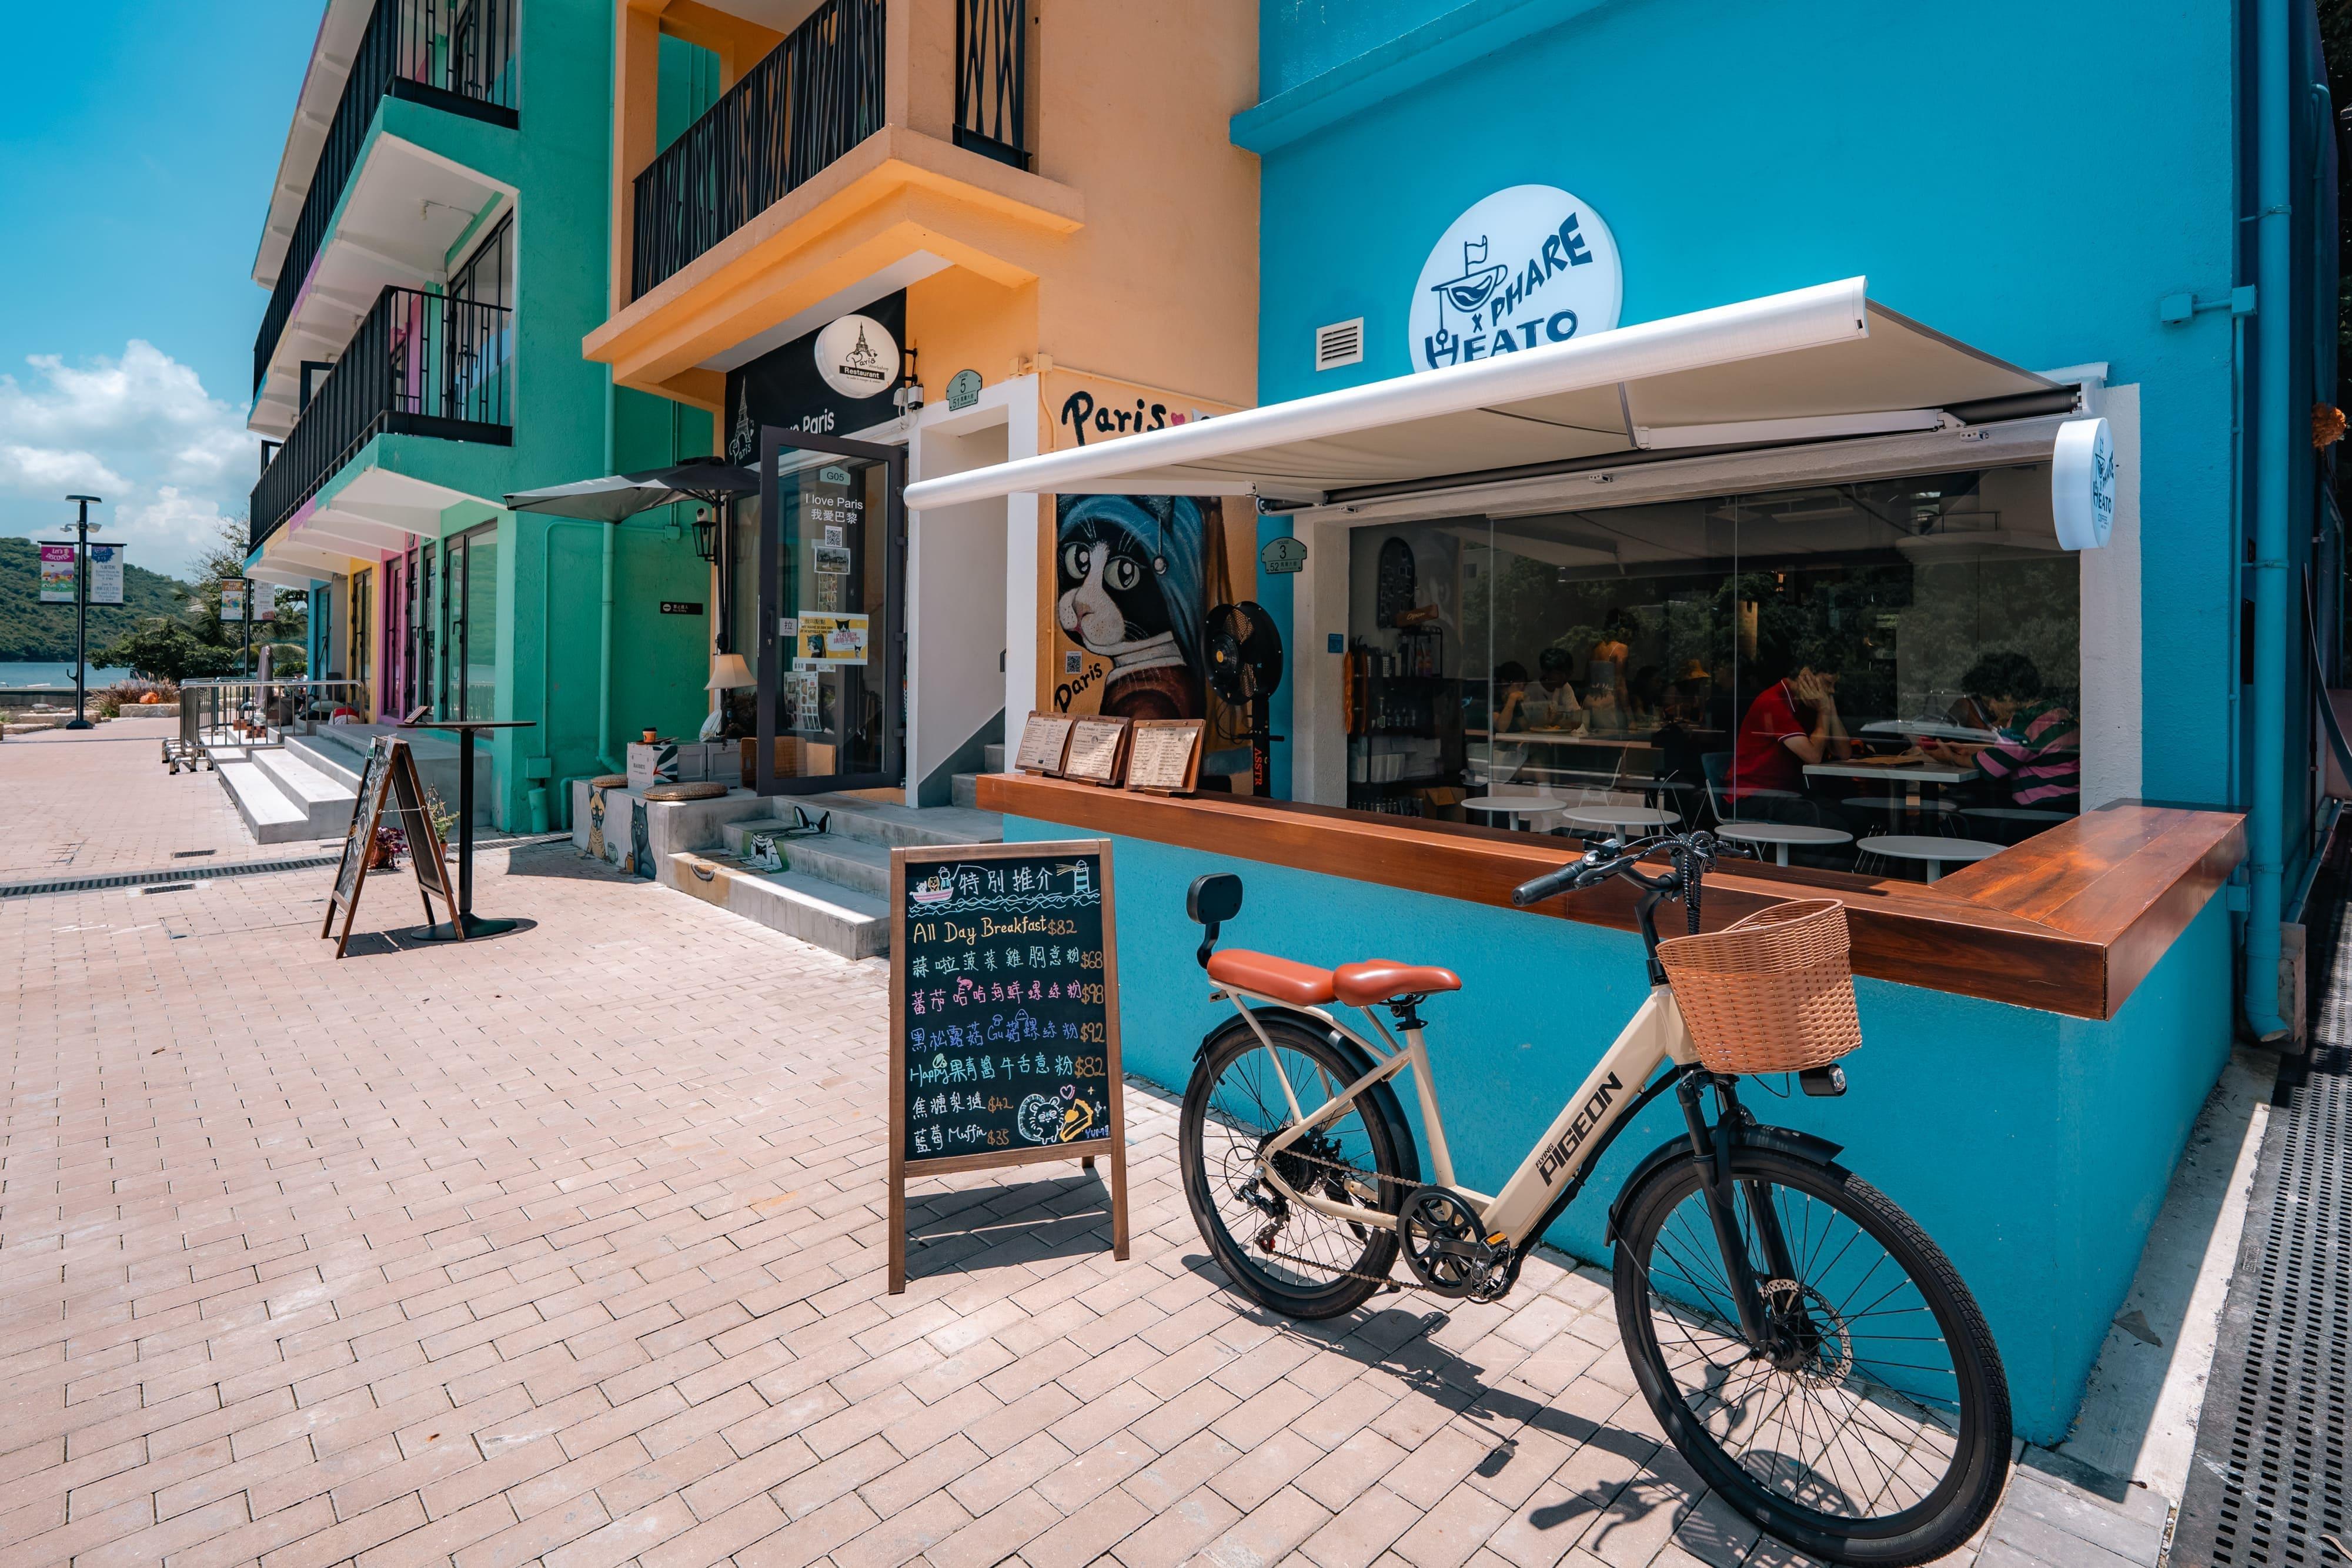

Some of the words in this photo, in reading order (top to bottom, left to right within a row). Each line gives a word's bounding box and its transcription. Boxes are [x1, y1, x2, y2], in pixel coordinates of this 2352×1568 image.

[1491, 212, 1593, 327] PHARE
[846, 352, 876, 369] Paris
[844, 367, 880, 379] Restaurant
[960, 378, 966, 393] 5
[953, 397, 960, 408] 51
[803, 408, 834, 434] Paris
[1061, 390, 1167, 447] Paris
[729, 439, 751, 466] Paris
[827, 472, 844, 482] G05
[806, 493, 808, 504] I
[812, 494, 834, 506] love
[837, 497, 863, 510] Paris
[2093, 481, 2112, 514] HEATO
[811, 509, 858, 524] 我愛巴黎
[1279, 545, 1287, 559] 3
[1269, 562, 1279, 571] 52
[784, 621, 793, 630] 拉
[1054, 662, 1103, 713] Paris
[958, 867, 1053, 895] 特別推介
[913, 923, 935, 944] All
[944, 921, 977, 945] Day
[981, 915, 1047, 938] Breakfast
[1048, 920, 1077, 936] $82
[1081, 951, 1103, 969] $68
[1081, 983, 1104, 1005] $98
[1080, 1022, 1105, 1043] $92
[1074, 1057, 1106, 1079] $82
[988, 1096, 1014, 1114] $42
[914, 1124, 943, 1153] 藍莓
[948, 1124, 987, 1143] Muffin
[987, 1129, 1010, 1146] $35
[1538, 1071, 1624, 1188] PIGEON
[1535, 1143, 1554, 1169] FLYING
